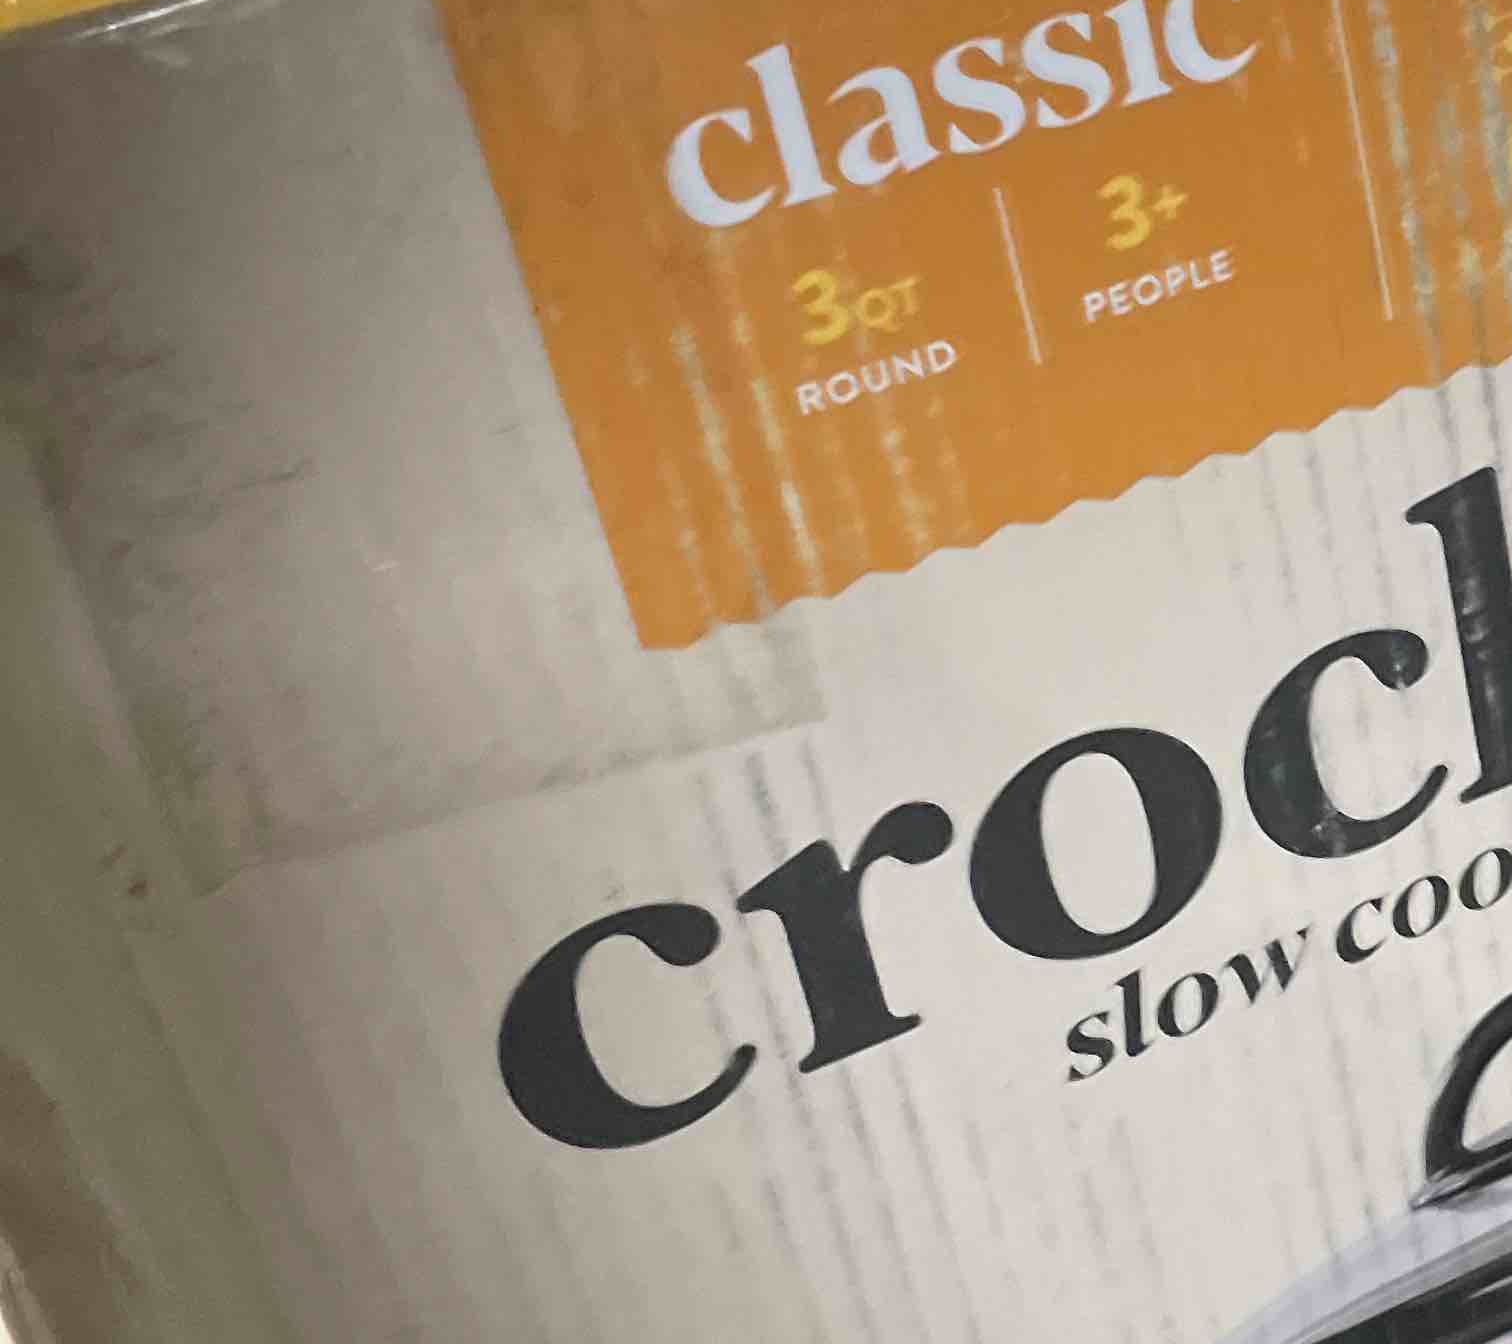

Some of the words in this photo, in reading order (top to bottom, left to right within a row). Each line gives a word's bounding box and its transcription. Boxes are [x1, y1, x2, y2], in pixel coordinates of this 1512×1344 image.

[1098, 174, 1189, 251] 3+
[1082, 249, 1237, 323] PEOPLE
[795, 338, 957, 415] ROUND
[1066, 922, 1315, 1082] slow
